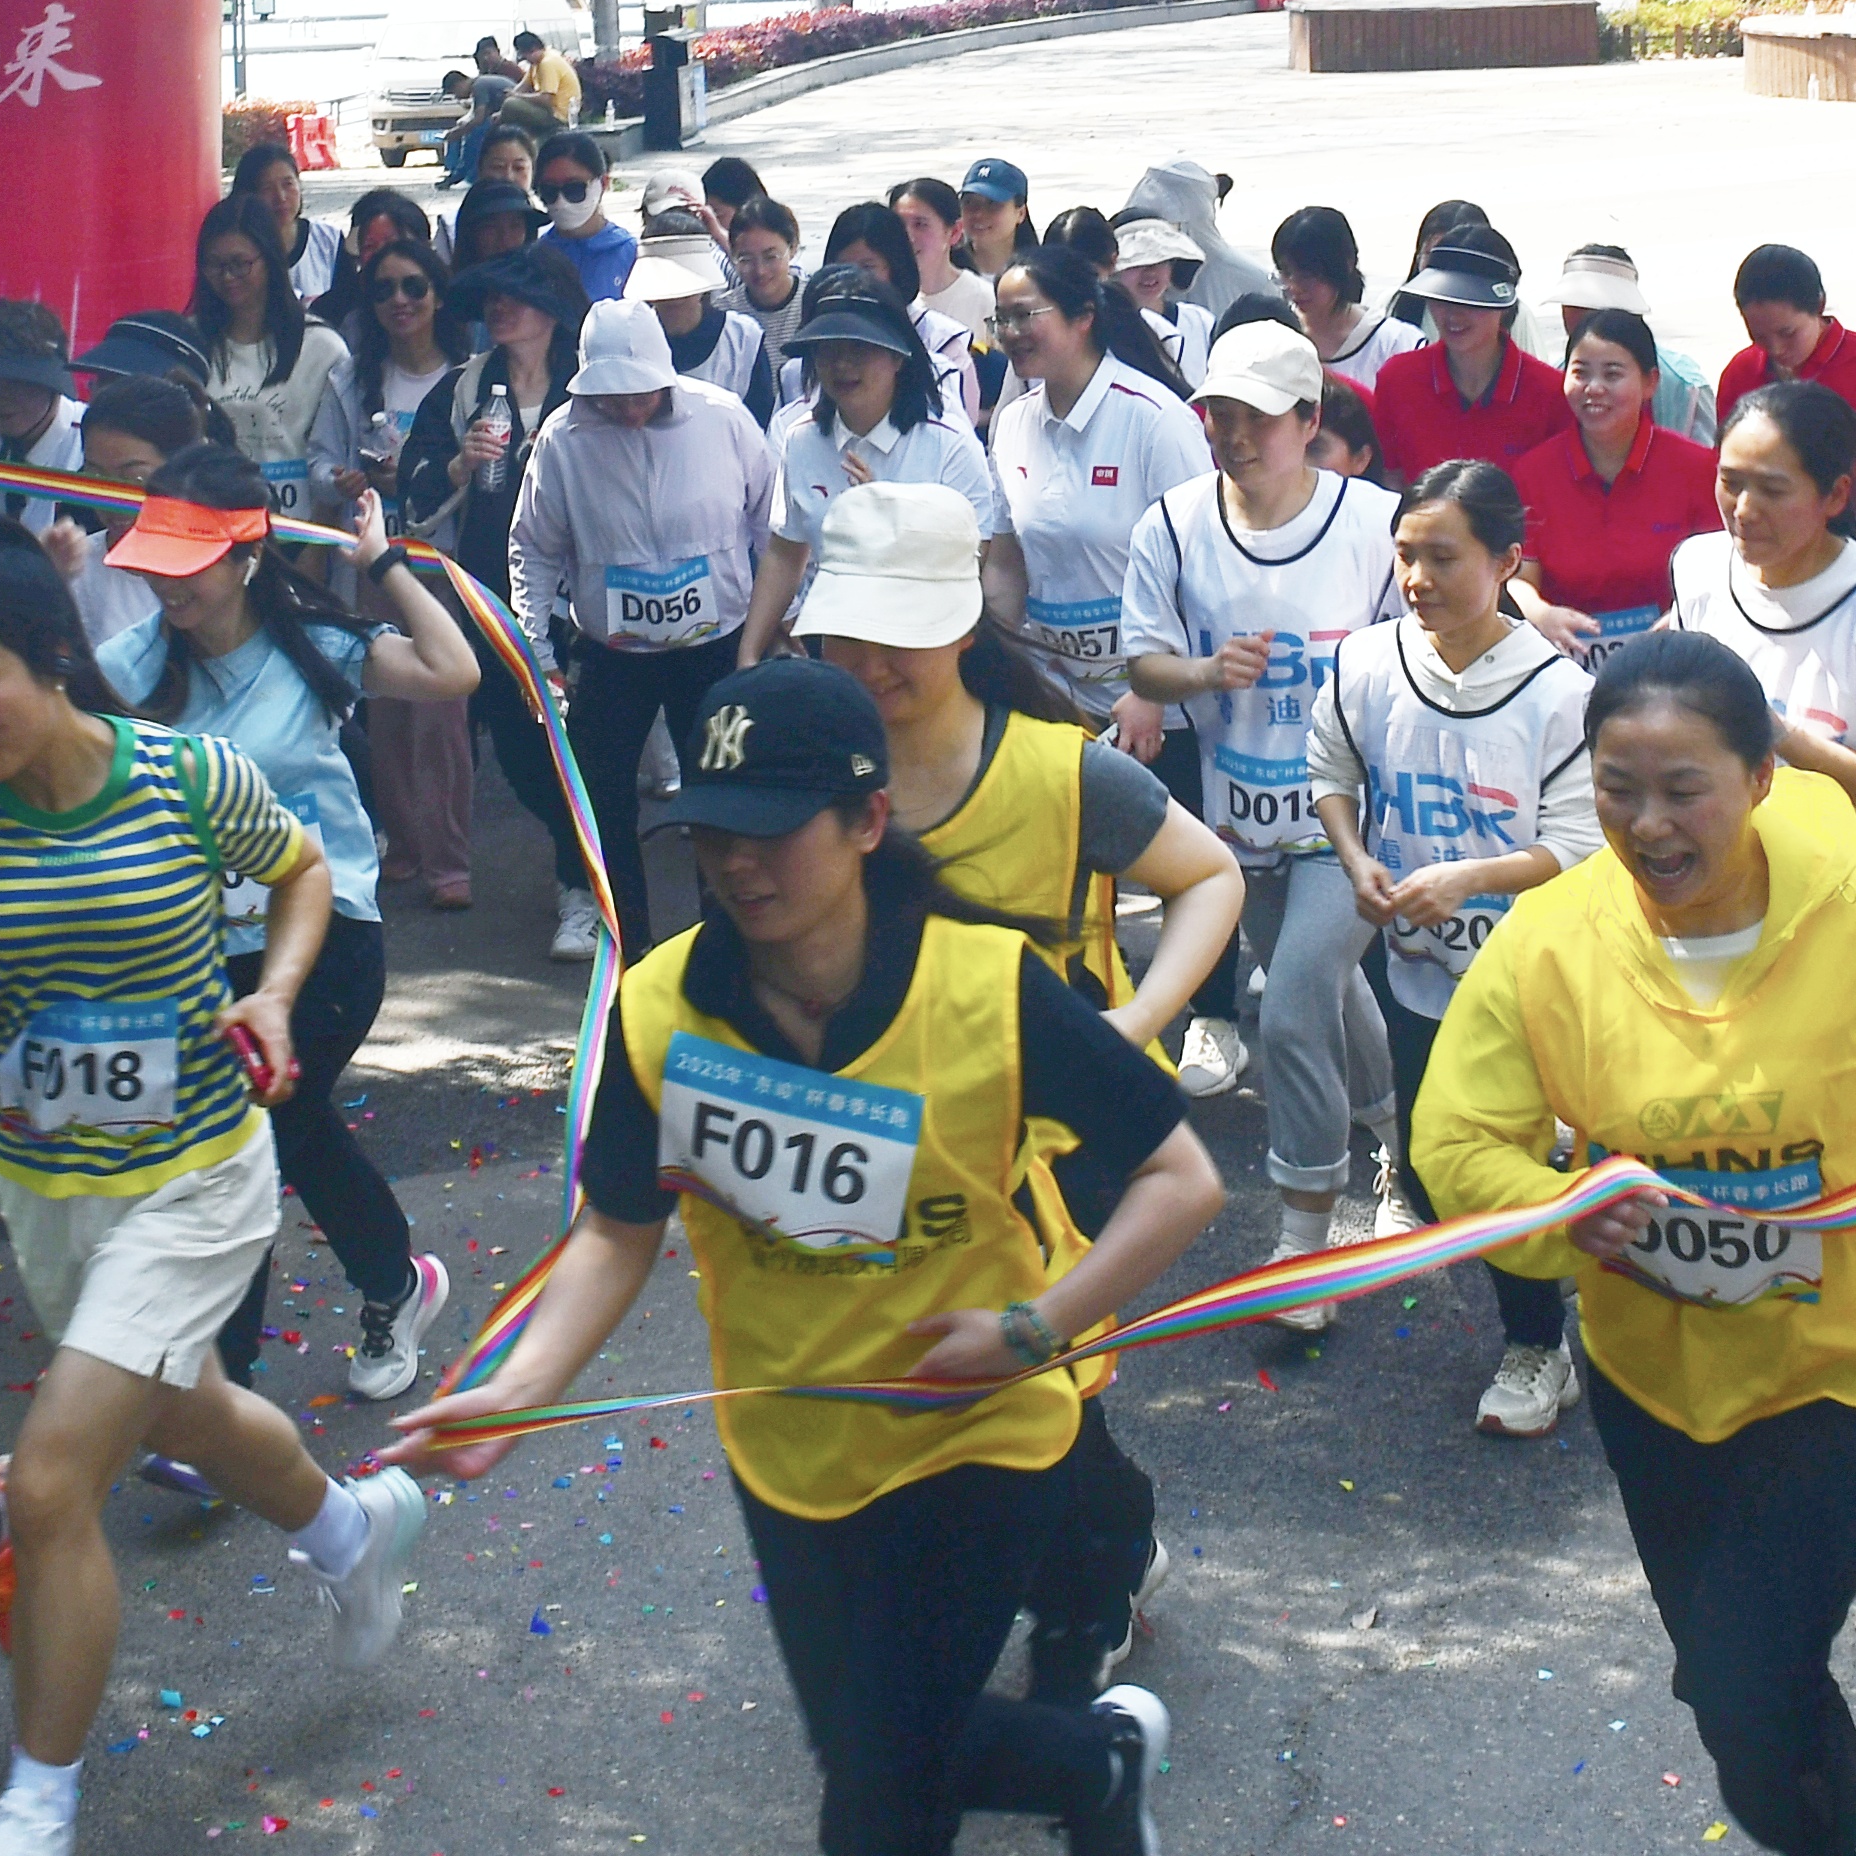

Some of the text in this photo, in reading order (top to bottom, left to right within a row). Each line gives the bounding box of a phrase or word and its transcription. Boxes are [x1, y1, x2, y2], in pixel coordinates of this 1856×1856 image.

[621, 587, 701, 624] D056
[19, 1040, 144, 1102] F018
[690, 1101, 872, 1206] F016
